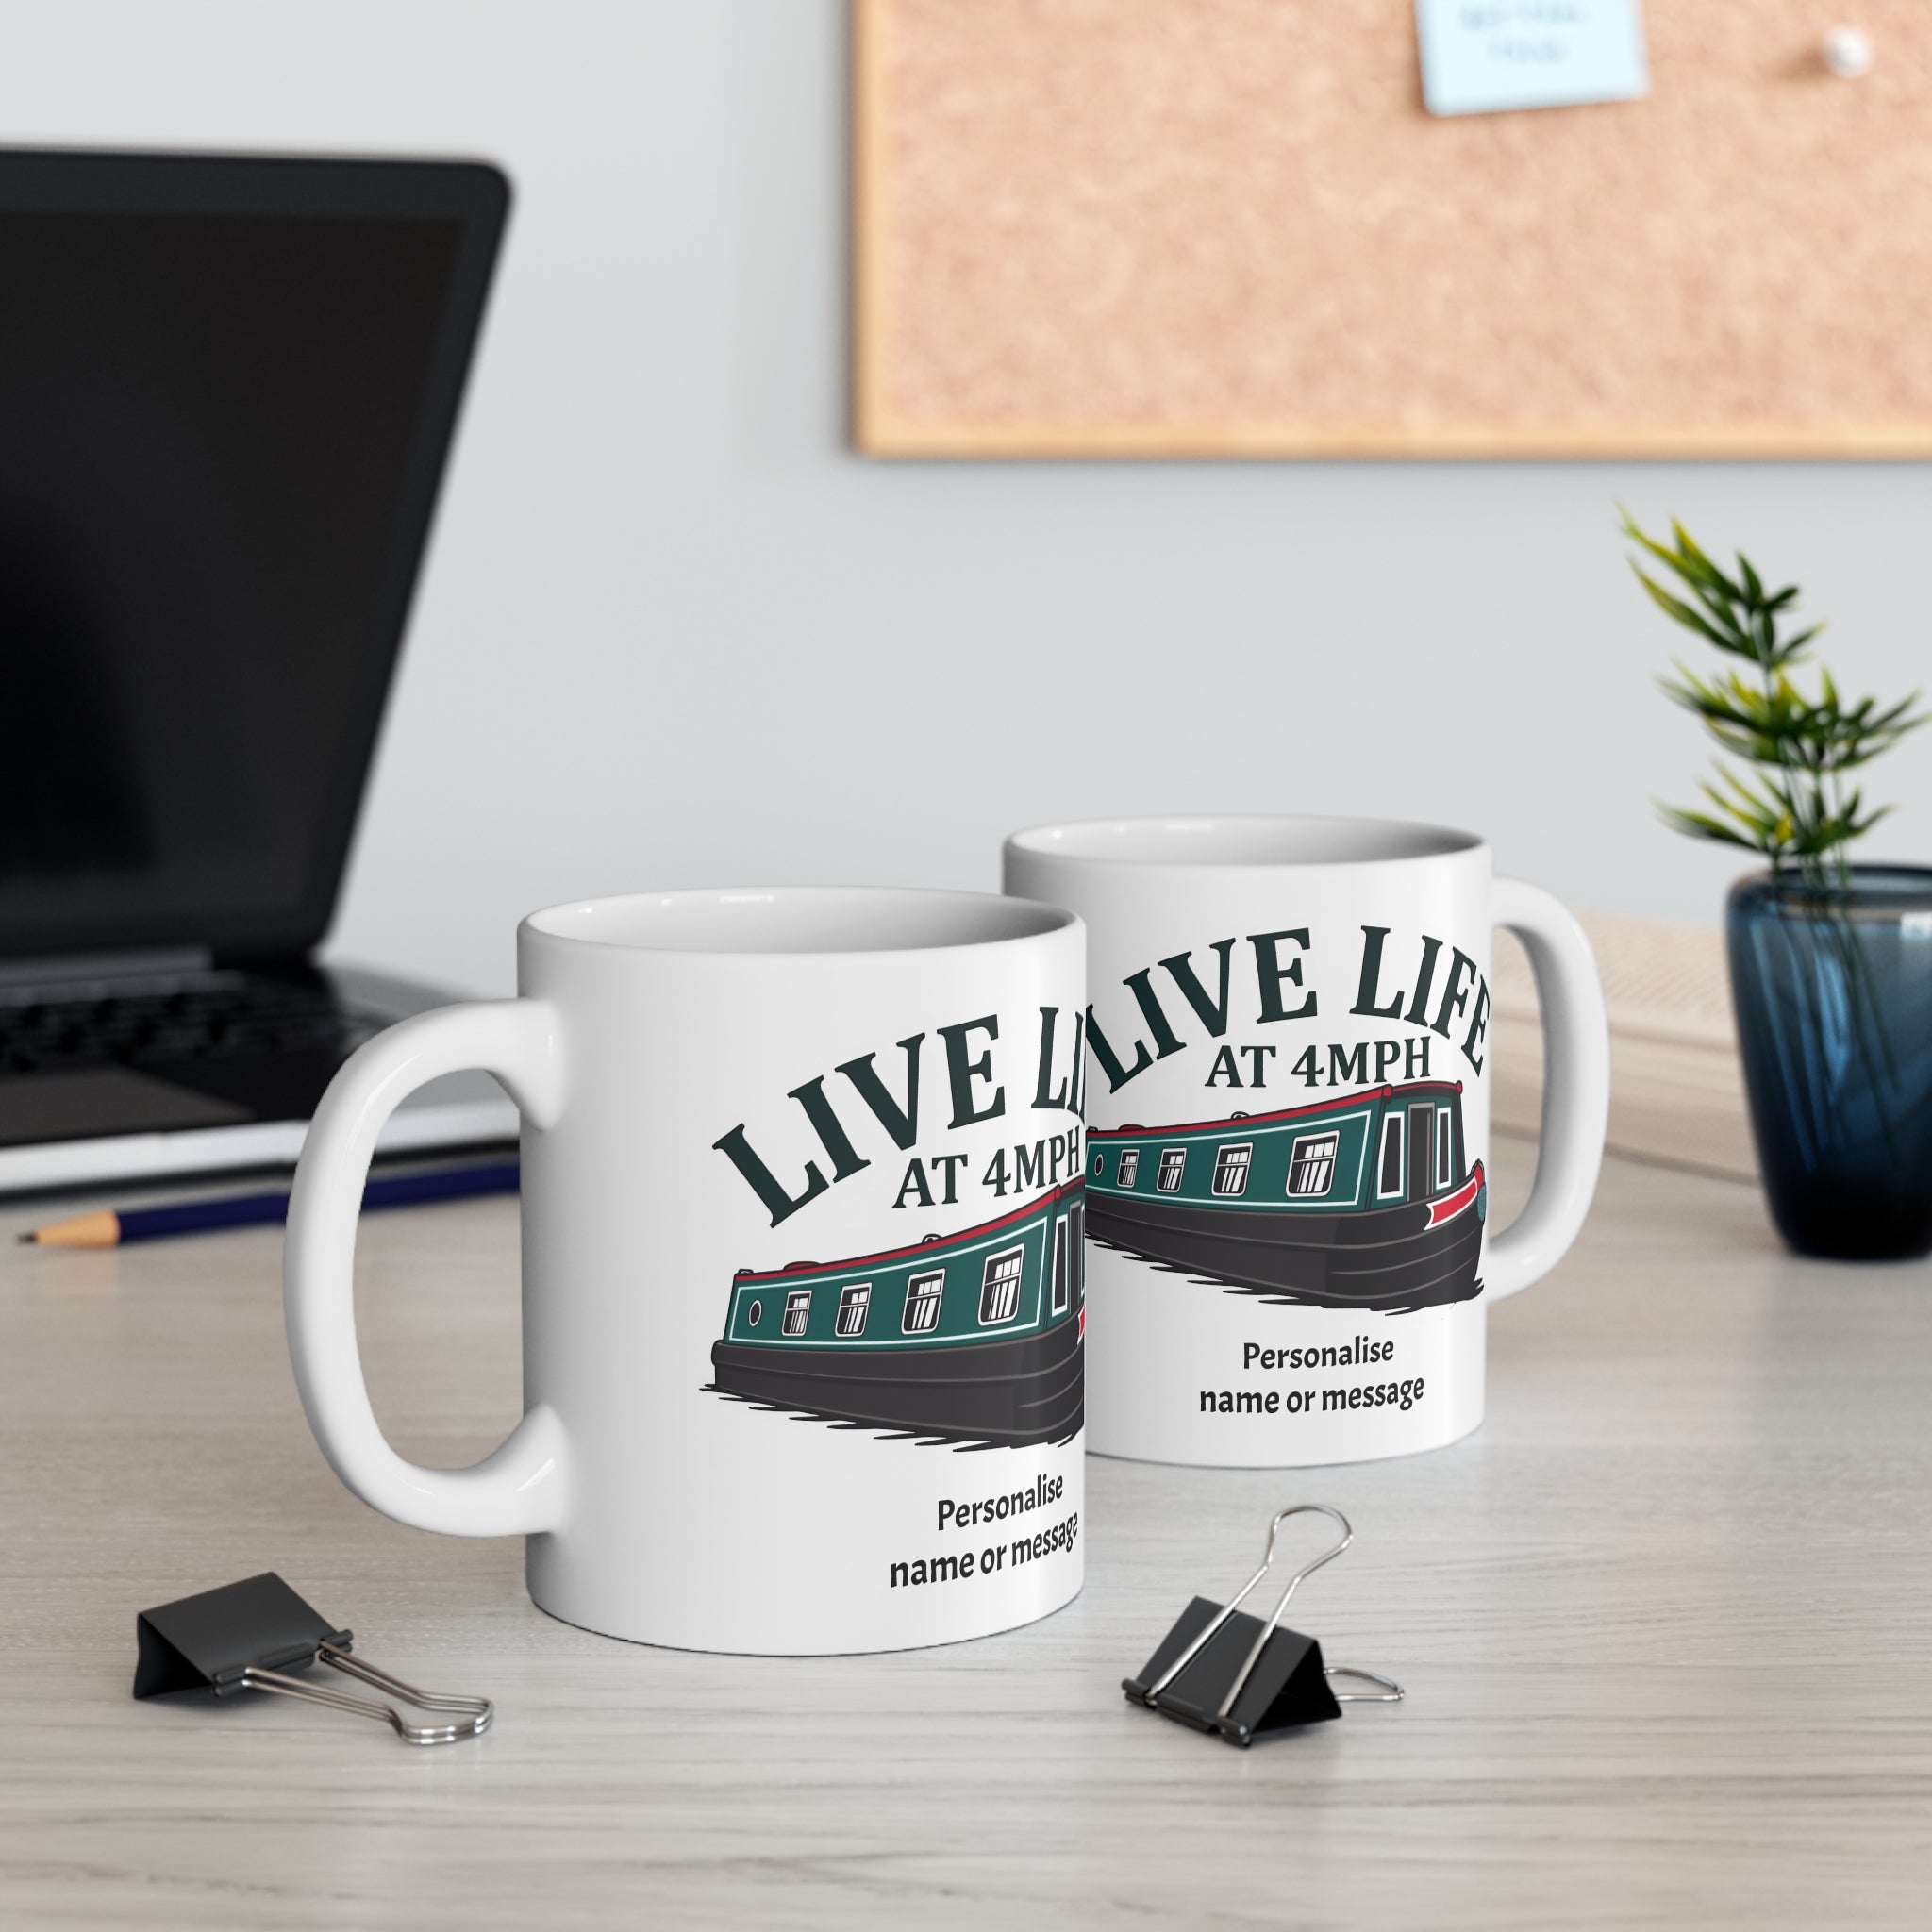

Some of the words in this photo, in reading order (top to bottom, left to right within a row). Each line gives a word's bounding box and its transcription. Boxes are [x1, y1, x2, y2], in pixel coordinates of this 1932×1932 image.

[1085, 927, 1318, 1095] LIVE
[1349, 925, 1491, 1078] LIFE
[1205, 1044, 1276, 1088] AT
[1291, 1035, 1431, 1088] 4MPH
[711, 1013, 1006, 1229] LIVE
[1031, 1007, 1085, 1126] LI
[891, 1154, 969, 1209] AT
[981, 1124, 1080, 1198] 4MPH
[1243, 1334, 1395, 1370] Personalise
[1200, 1391, 1280, 1414] name
[1286, 1391, 1316, 1414] or
[1322, 1377, 1424, 1411] message
[938, 1473, 1063, 1531] Personalise
[890, 1552, 974, 1588] name
[980, 1545, 1008, 1574] or
[1011, 1511, 1078, 1567] message
